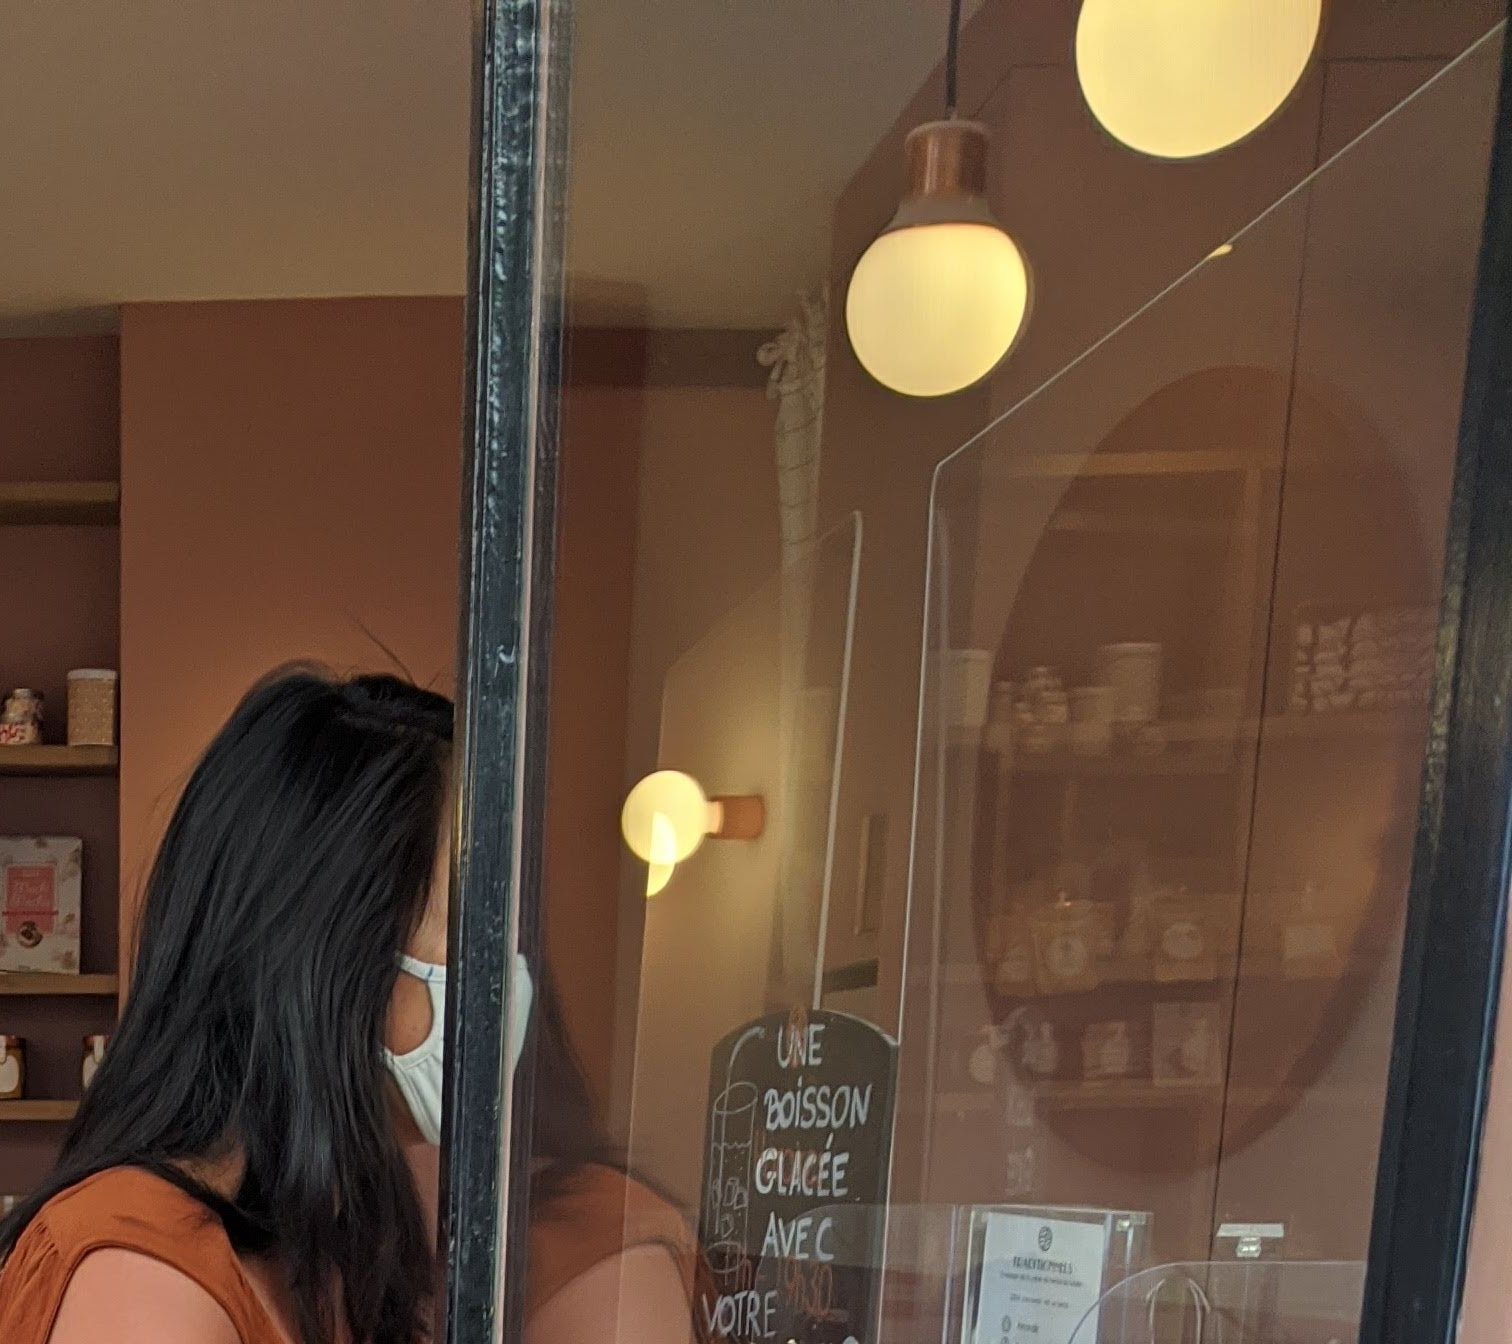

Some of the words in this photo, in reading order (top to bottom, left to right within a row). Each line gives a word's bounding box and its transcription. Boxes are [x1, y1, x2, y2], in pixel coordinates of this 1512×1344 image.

[777, 1023, 825, 1069] UNE
[755, 1132, 850, 1197] GLACÉE
[760, 1211, 835, 1263] AVEC
[702, 1289, 778, 1338] VOTRE
